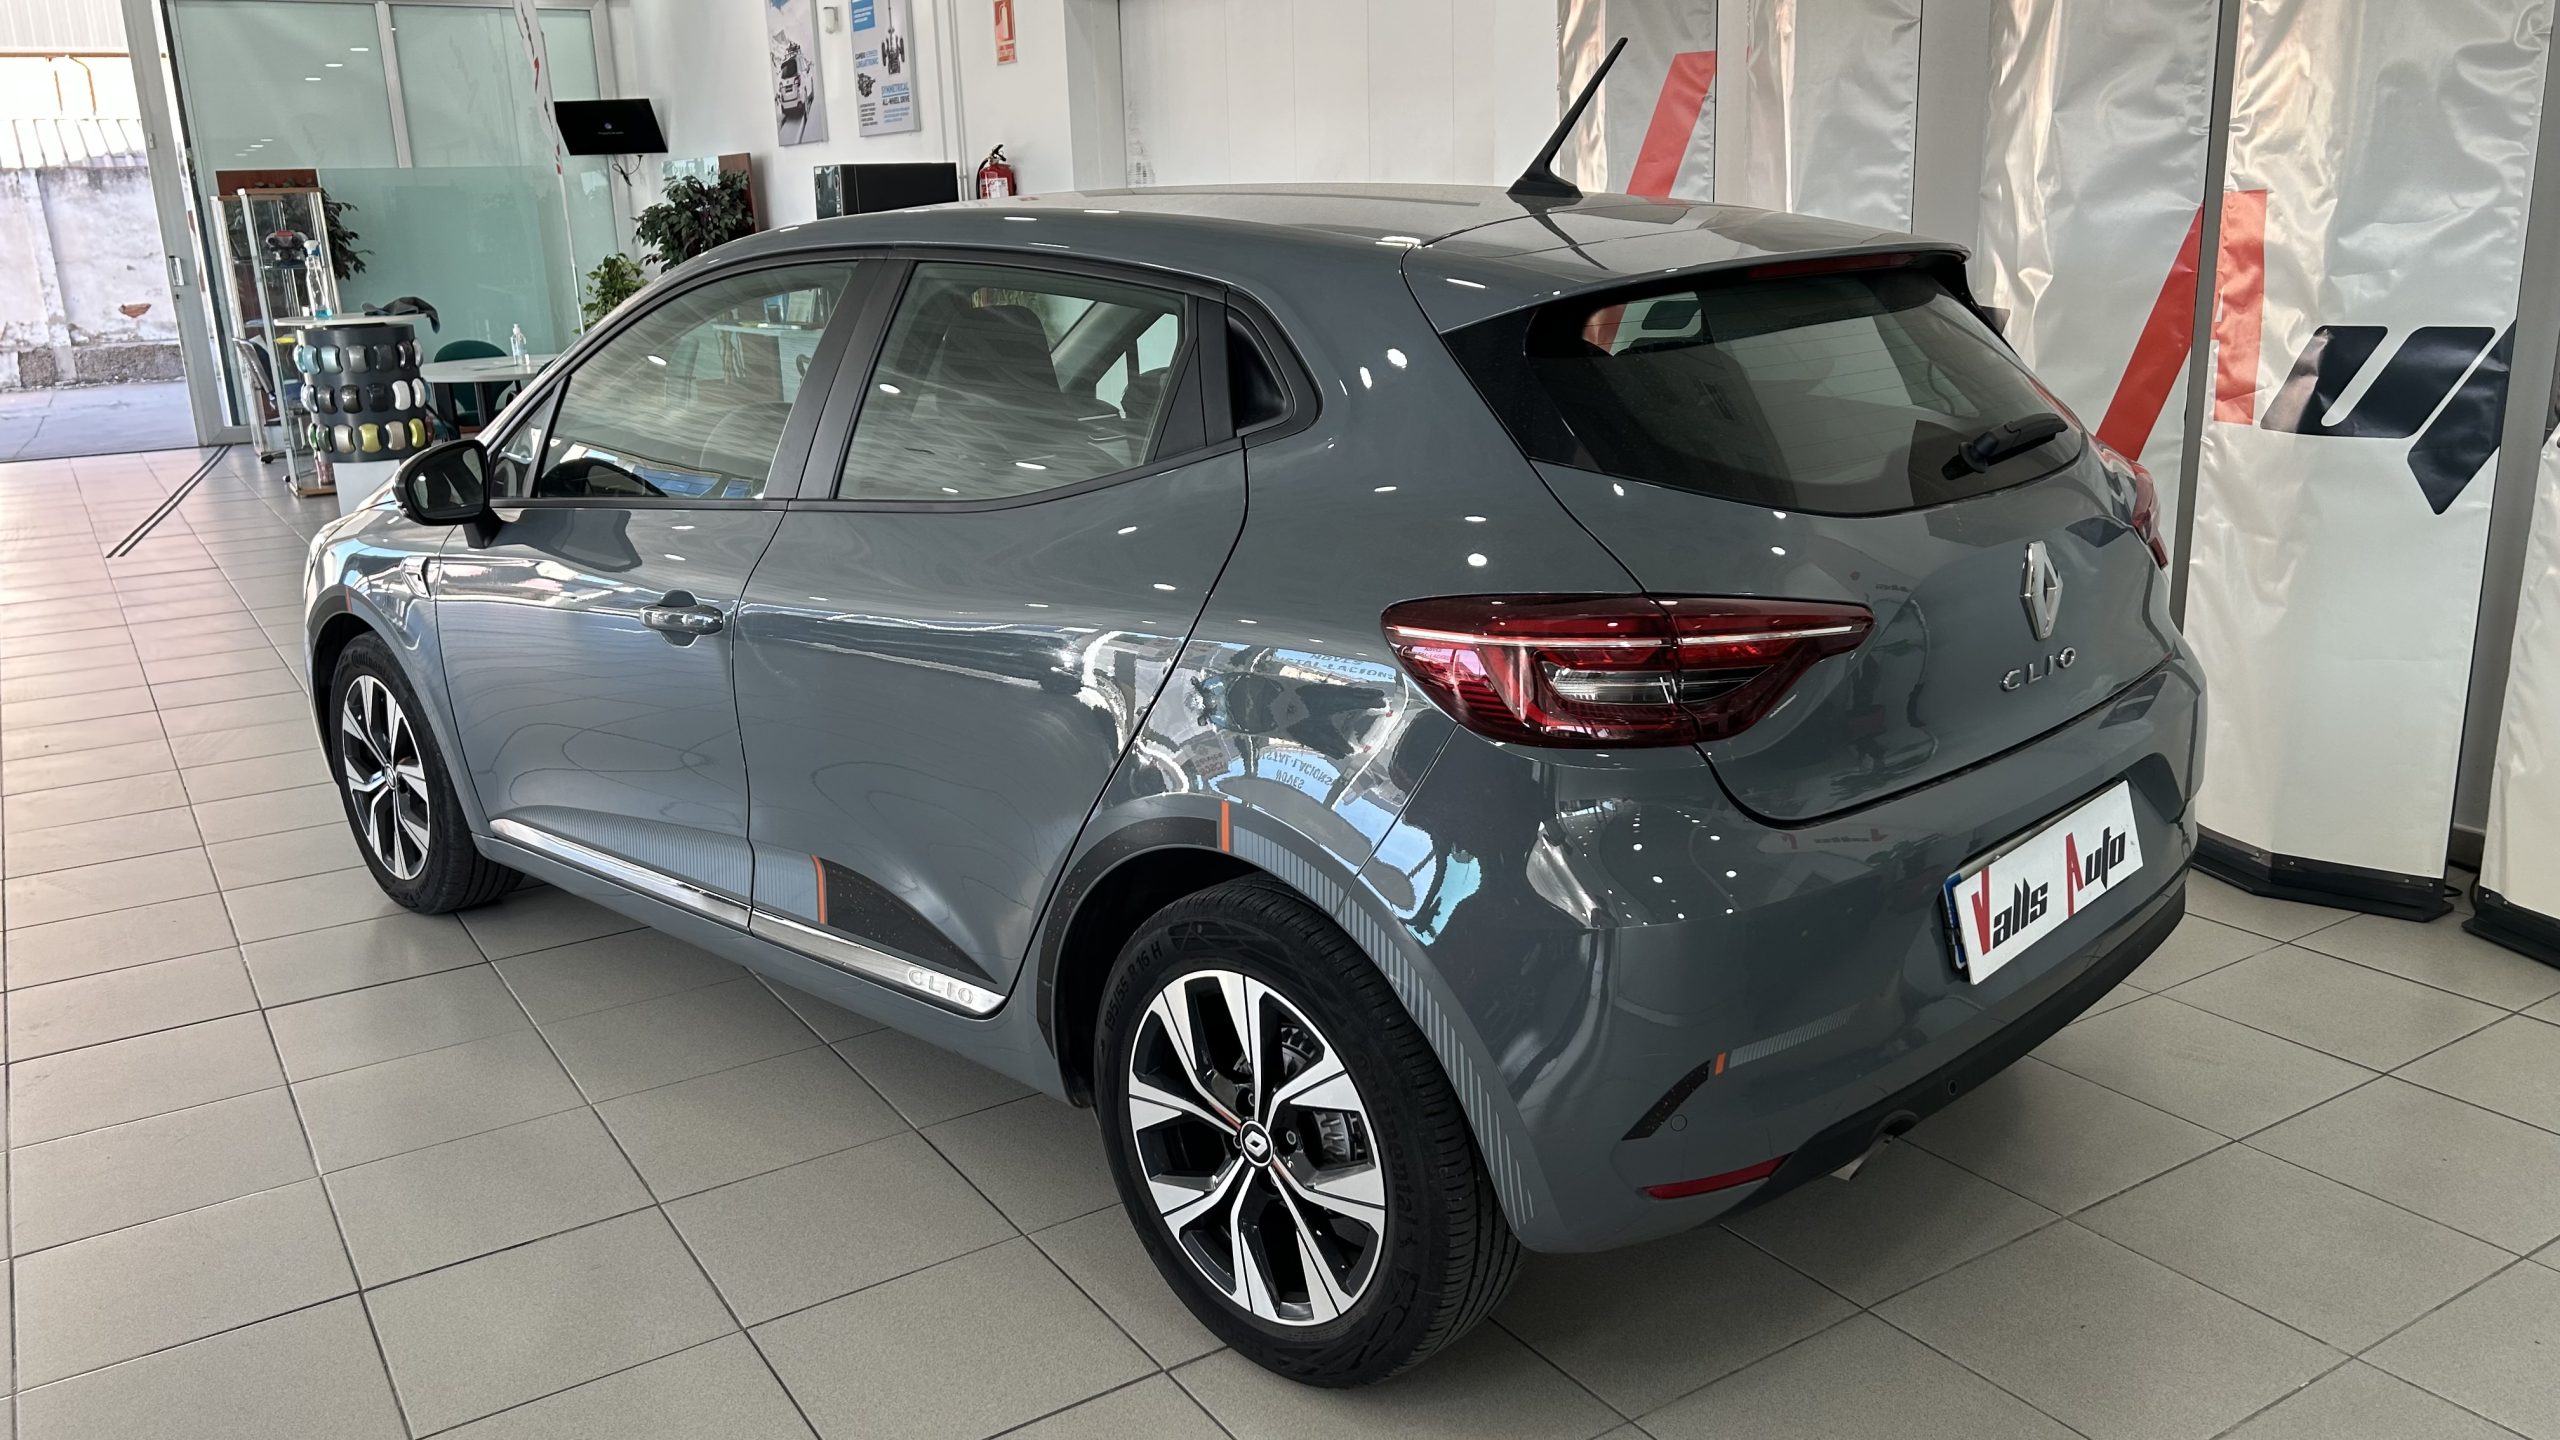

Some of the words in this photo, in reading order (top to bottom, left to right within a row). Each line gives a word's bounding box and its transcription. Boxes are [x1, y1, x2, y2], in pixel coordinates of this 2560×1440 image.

[2001, 647, 2076, 691] CLIO
[1971, 865, 2048, 956] Valls
[2065, 826, 2126, 918] Auto
[1136, 950, 1151, 972] 16
[1150, 940, 1163, 960] H
[908, 969, 974, 1004] CLIO
